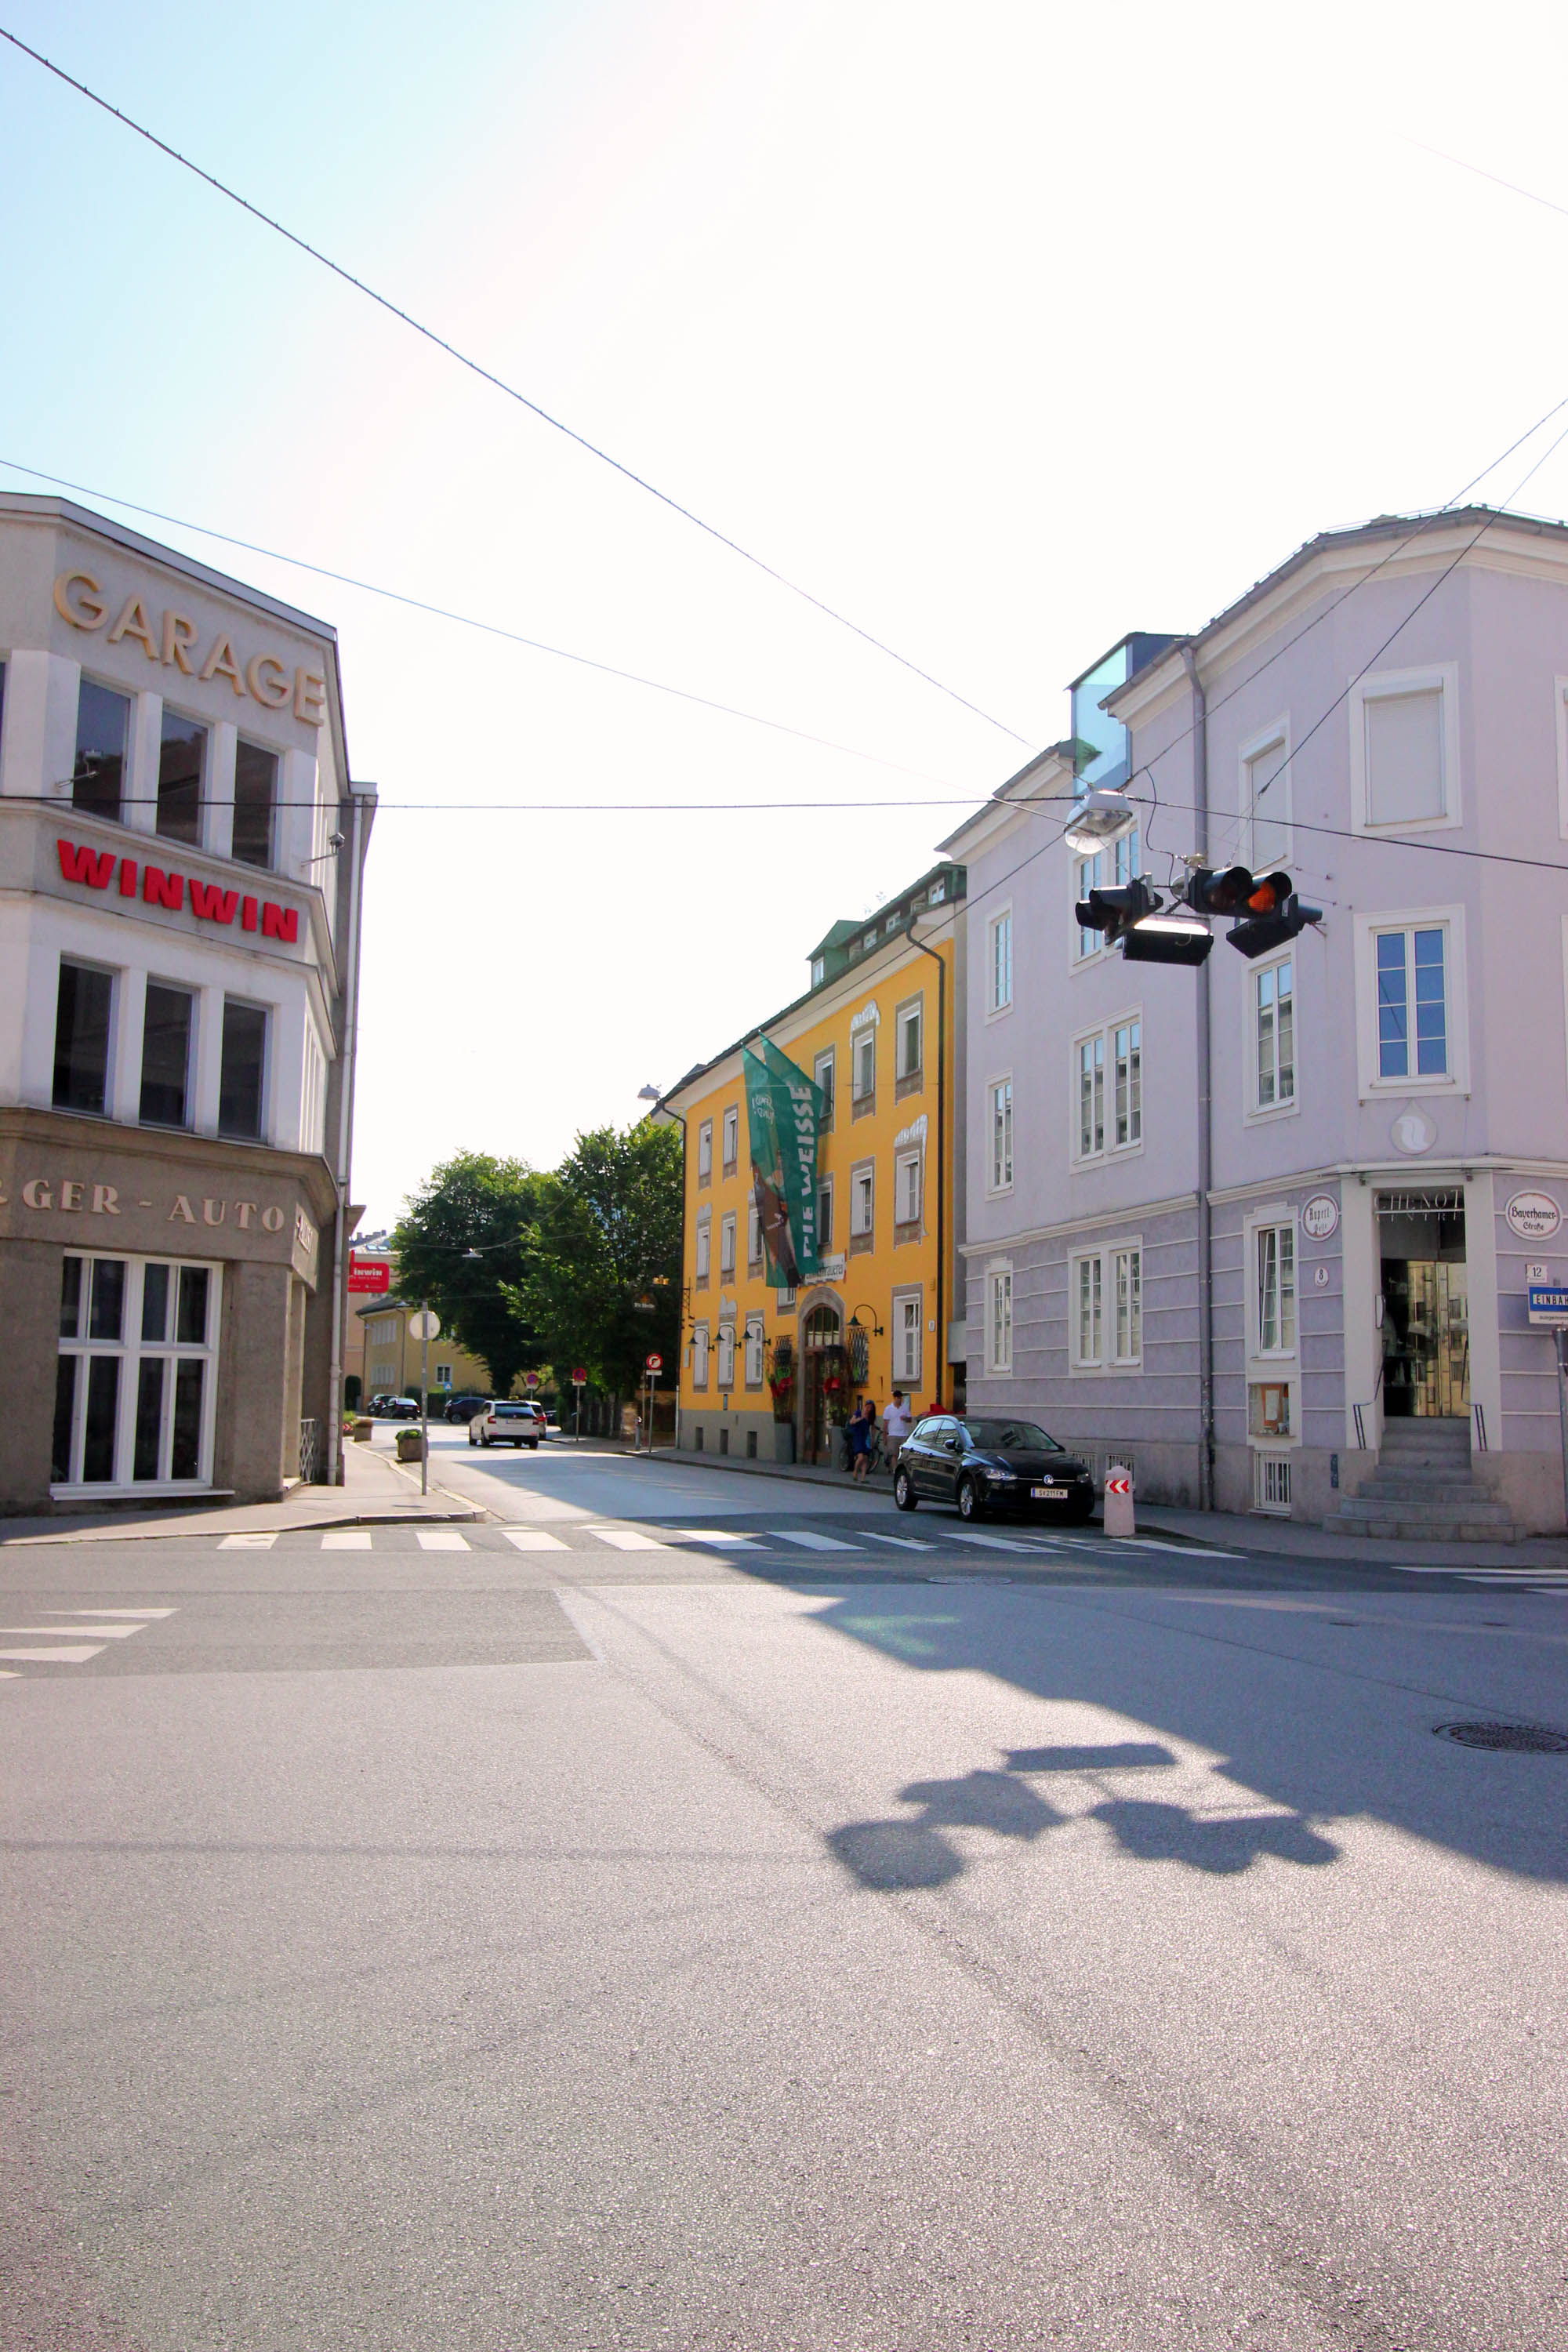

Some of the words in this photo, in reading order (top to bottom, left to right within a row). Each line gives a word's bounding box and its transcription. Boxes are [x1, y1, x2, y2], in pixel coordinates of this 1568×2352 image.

[54, 570, 325, 727] GARAGE
[57, 839, 298, 943] WINWIN
[788, 1082, 814, 1196] WEISSE
[166, 1194, 285, 1232] AUTO
[1512, 1206, 1556, 1221] Bayerhamer-
[1319, 1269, 1323, 1279] 8
[1533, 1266, 1542, 1277] 12
